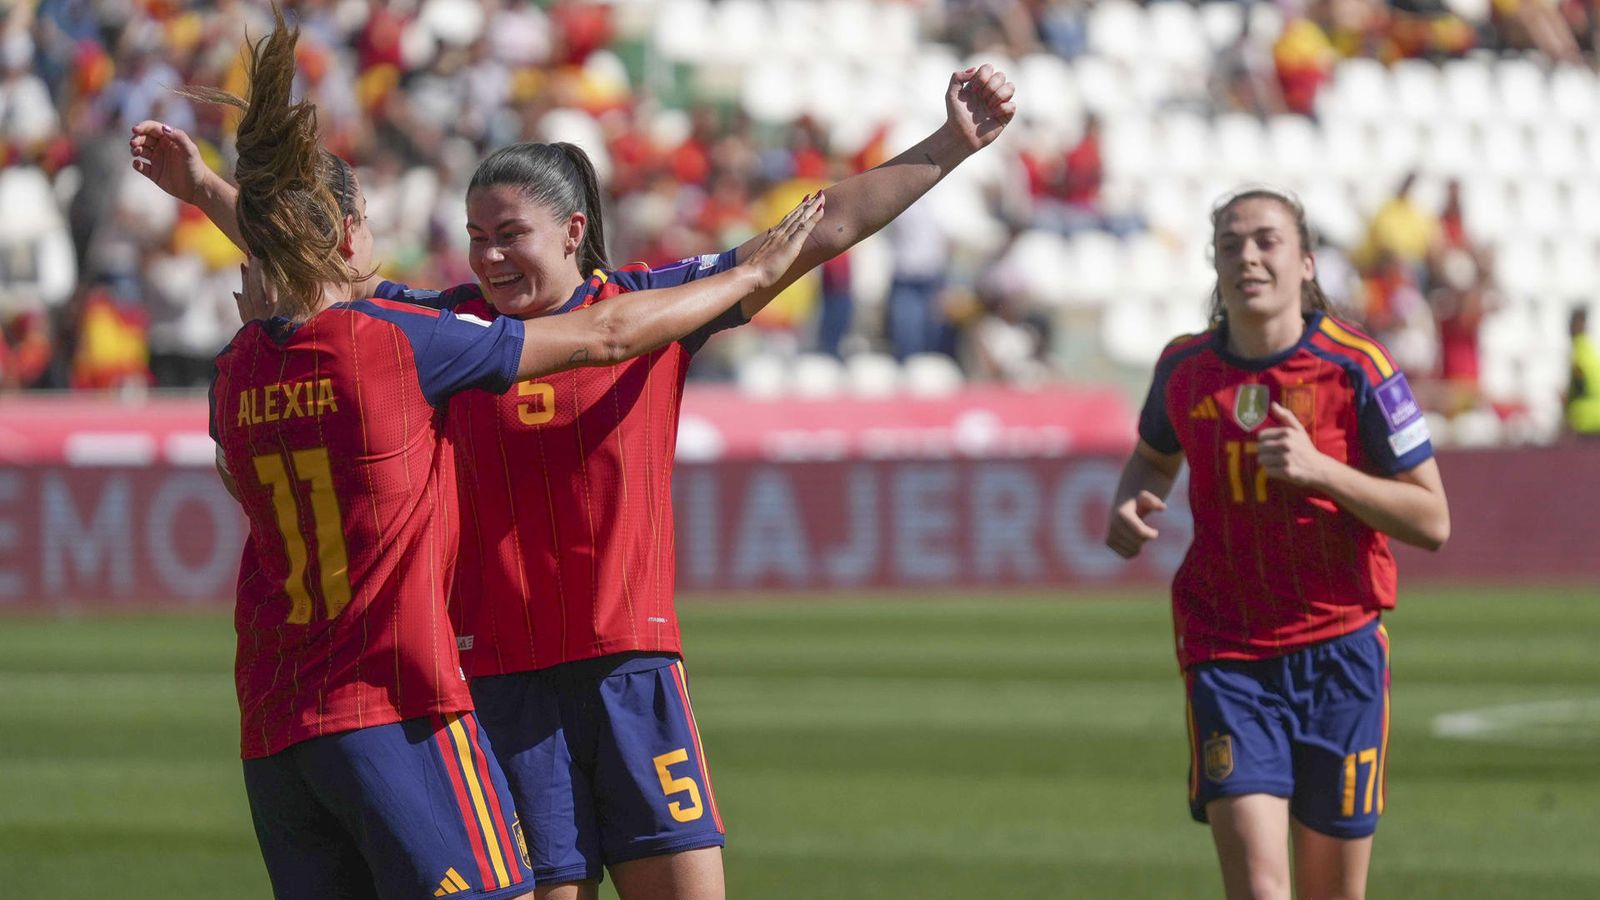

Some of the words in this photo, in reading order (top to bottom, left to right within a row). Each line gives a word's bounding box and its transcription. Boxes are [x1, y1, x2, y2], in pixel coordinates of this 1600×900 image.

[237, 378, 339, 427] ALEXIA
[517, 380, 555, 425] 5
[1226, 440, 1268, 503] 17
[252, 447, 352, 624] 11
[653, 747, 704, 823] 5
[1342, 747, 1378, 817] 17
